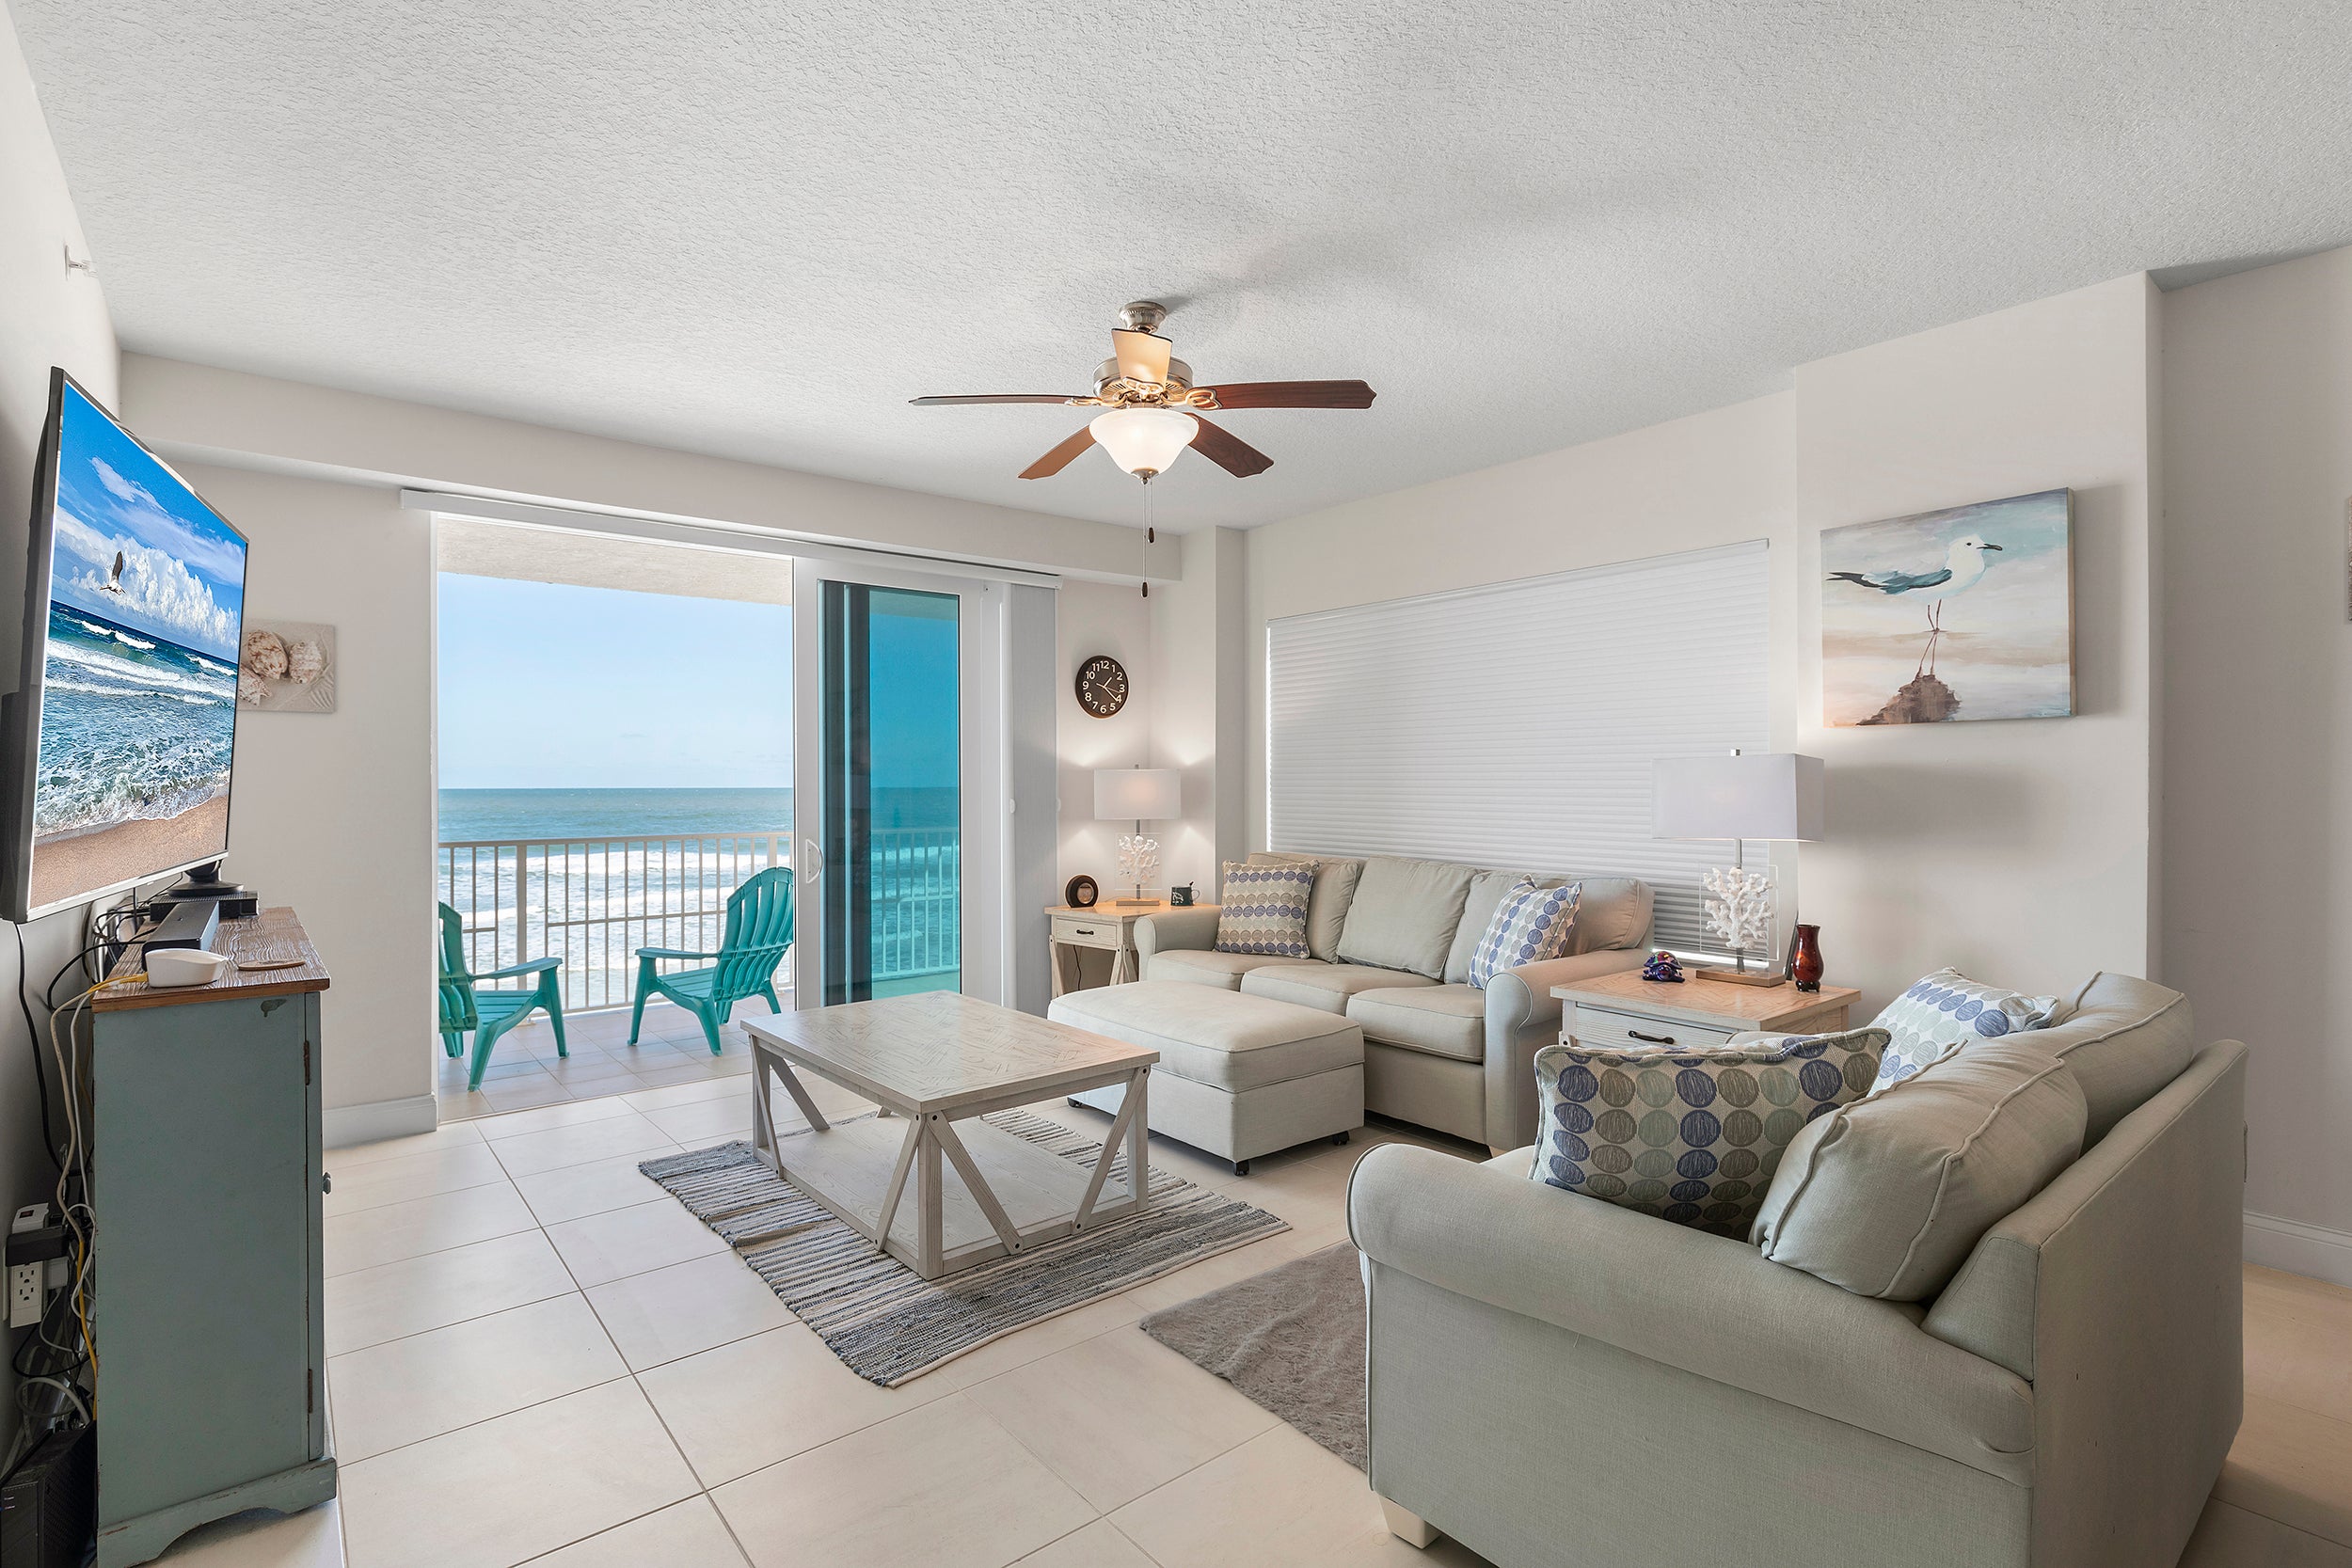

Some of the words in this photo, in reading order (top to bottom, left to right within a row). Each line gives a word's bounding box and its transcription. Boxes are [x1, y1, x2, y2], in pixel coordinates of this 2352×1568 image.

[1092, 663, 1100, 672] 11
[1086, 671, 1095, 679] 10
[1083, 681, 1089, 690] 9
[1085, 692, 1092, 701] 8
[1100, 705, 1107, 713] 6
